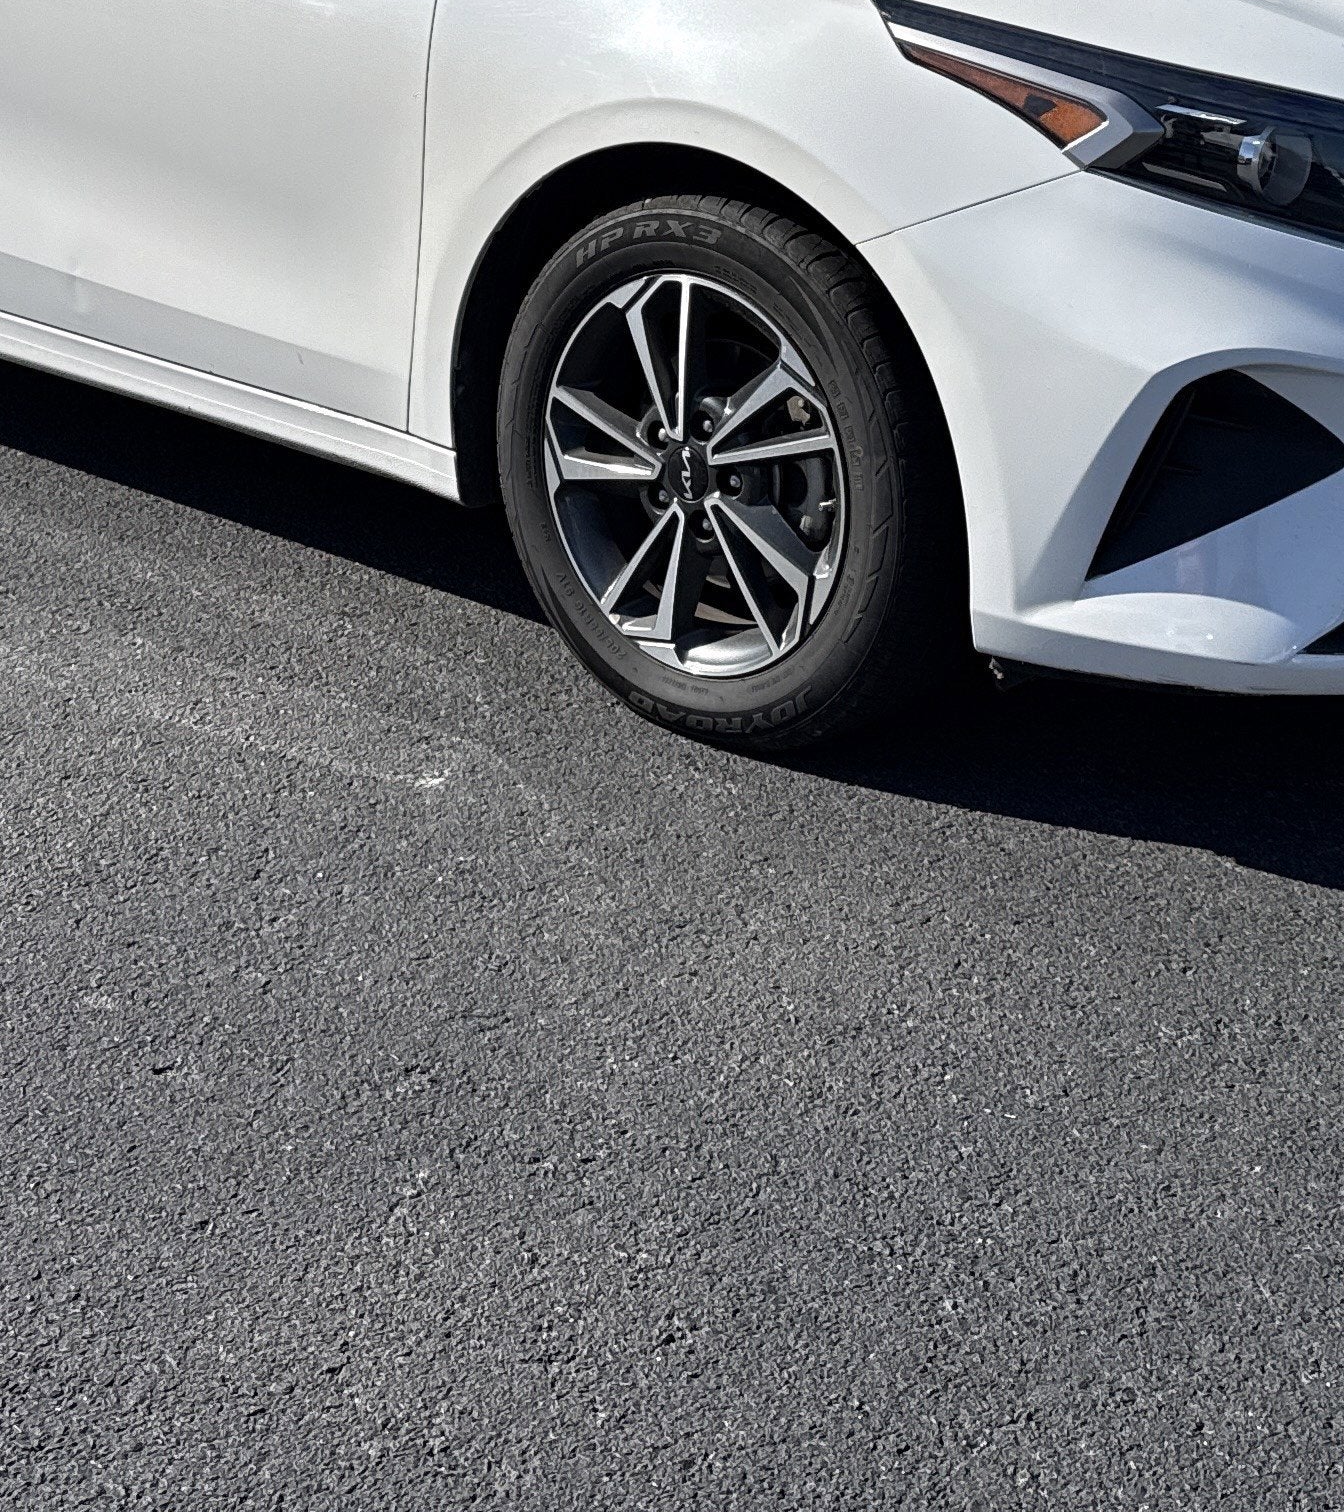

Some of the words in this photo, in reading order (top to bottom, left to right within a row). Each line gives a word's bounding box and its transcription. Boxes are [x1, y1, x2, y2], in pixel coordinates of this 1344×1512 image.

[575, 226, 625, 269] HP
[632, 219, 723, 245] RX3
[628, 684, 813, 734] JOYROAD
